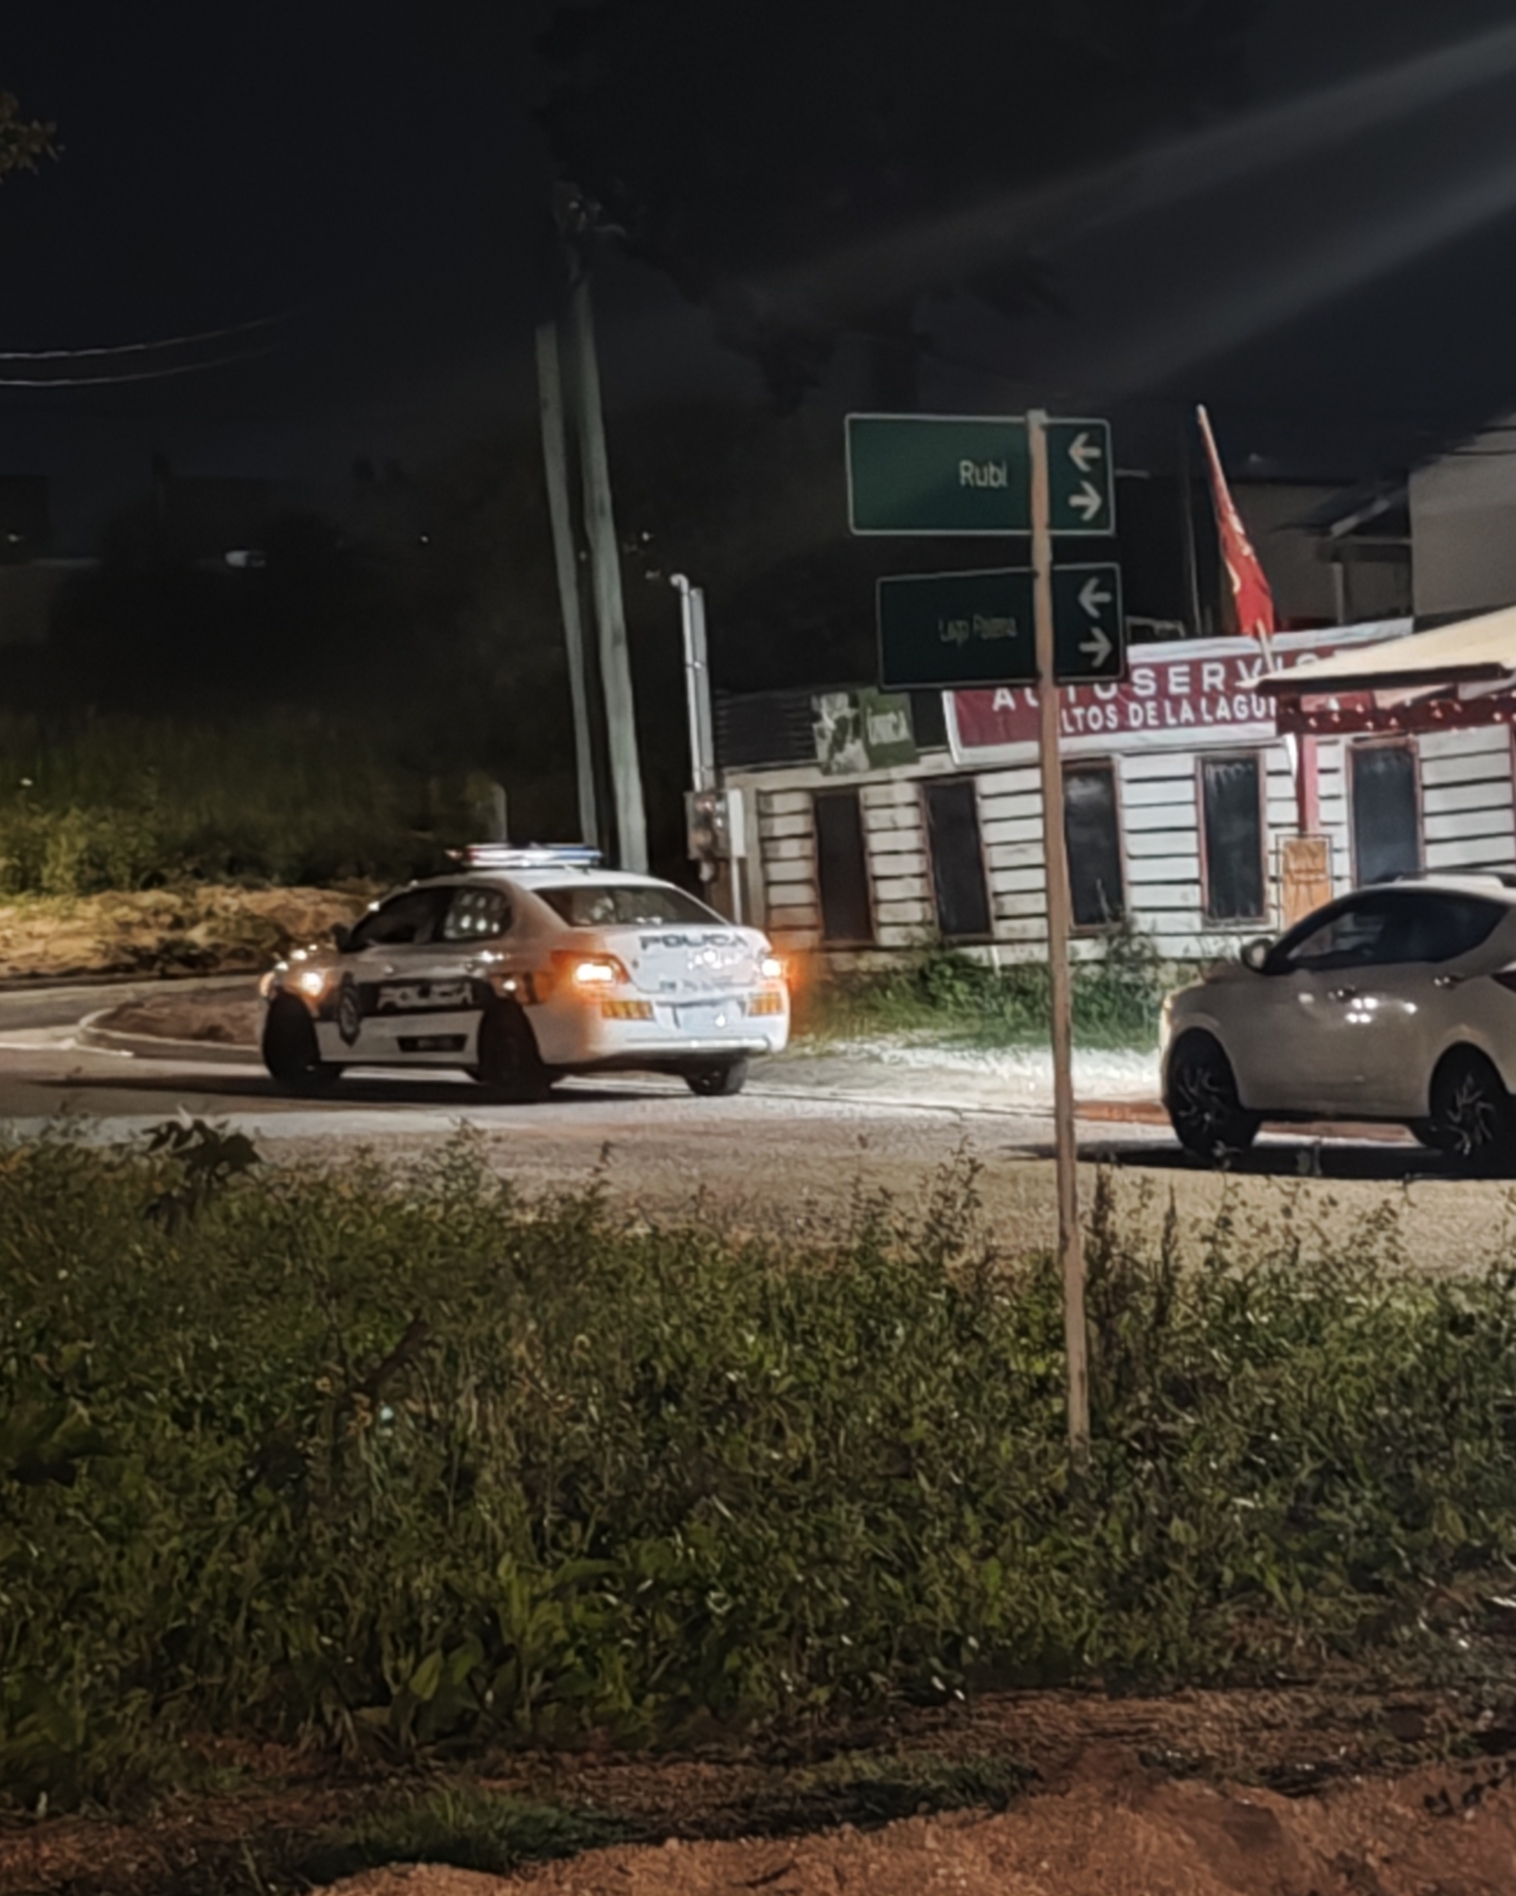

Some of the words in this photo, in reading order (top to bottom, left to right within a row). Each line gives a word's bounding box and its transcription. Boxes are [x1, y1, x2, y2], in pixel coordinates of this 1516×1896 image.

[1061, 702, 1119, 734] LTOS
[1128, 701, 1159, 728] DE
[1164, 699, 1195, 725] LA
[1201, 694, 1277, 722] LAGU
